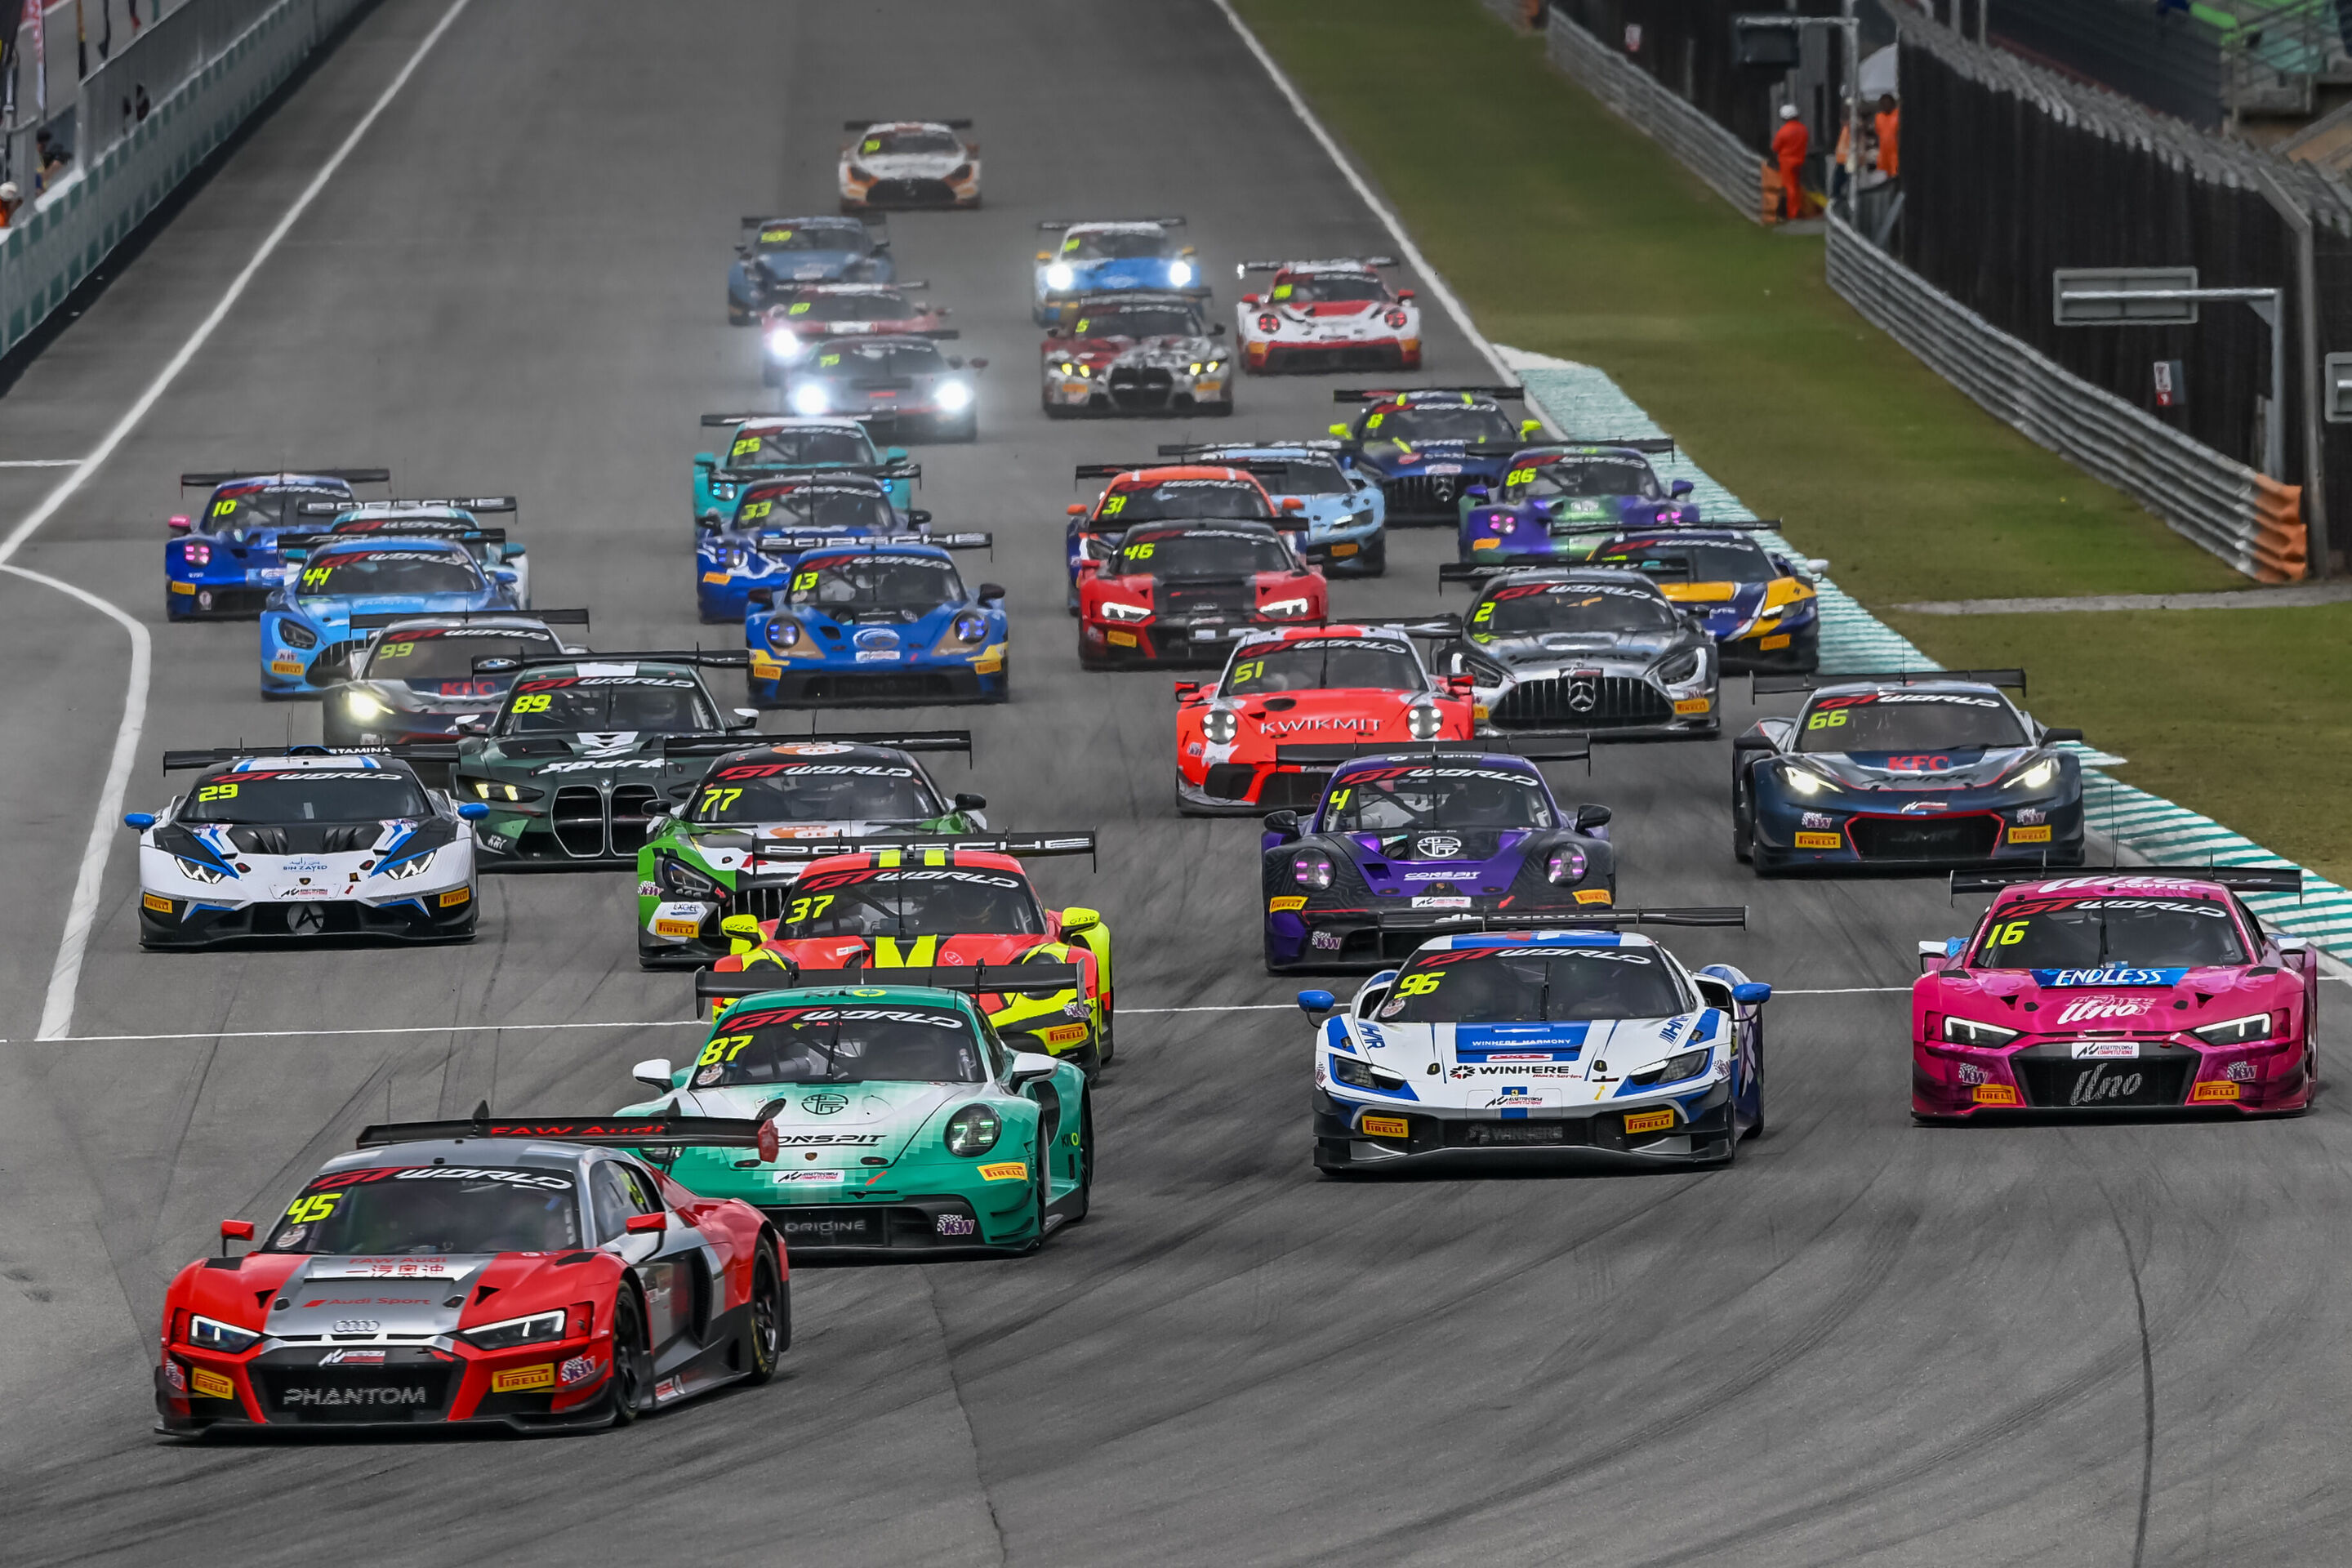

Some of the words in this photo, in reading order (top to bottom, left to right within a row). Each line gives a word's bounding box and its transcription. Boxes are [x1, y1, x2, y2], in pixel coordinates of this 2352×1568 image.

[212, 500, 237, 518] 10
[761, 532, 987, 548] PORSCHE
[302, 567, 333, 586] 44
[792, 572, 818, 591] 13
[1473, 601, 1496, 622] 2
[379, 643, 415, 660] 99
[1234, 661, 1264, 684] 51
[439, 681, 495, 697] KFC
[577, 677, 695, 688] WORLD
[511, 694, 552, 714] 89
[1878, 694, 2001, 707] WORLD
[1260, 719, 1384, 734] KWIKMIT
[1807, 709, 1849, 730] 66
[716, 763, 808, 781] GT
[782, 765, 913, 777] WORLD
[1887, 755, 1949, 771] KFC
[211, 771, 297, 783] GT
[274, 773, 403, 781] WORLD
[1337, 766, 1431, 786] GT
[1407, 768, 1539, 786] WORLD
[198, 783, 238, 803] 29
[700, 788, 743, 813] 77
[1329, 789, 1352, 811] 4
[764, 837, 1091, 854] PORSCHE
[1798, 835, 1837, 846] PIRELLI
[801, 868, 902, 892] GT
[875, 871, 1020, 889] WORLD
[2114, 883, 2191, 891] COFFEE
[786, 895, 835, 924] 37
[1997, 898, 2103, 919] GT
[2073, 900, 2227, 918] WORLD
[658, 922, 695, 934] PIRELLI
[1985, 921, 2029, 949] 16
[1416, 947, 1524, 968] GT
[1494, 948, 1652, 964] WORLD
[1393, 972, 1446, 999] 96
[2055, 969, 2167, 987] ENDLESS
[719, 1007, 832, 1032] GT
[800, 1009, 964, 1030] WORLD
[1049, 1026, 1084, 1042] PIRELLI
[699, 1034, 754, 1067] 87
[1479, 1065, 1570, 1075] WINHERE
[1976, 1087, 2016, 1102] PIRELLI
[2197, 1083, 2236, 1098] PIRELLI
[491, 1126, 573, 1135] FAW
[1365, 1120, 1404, 1134] PIRELLI
[1628, 1113, 1670, 1130] PIRELLI
[777, 1134, 888, 1144] ONSPIT
[309, 1166, 430, 1191] GT
[393, 1168, 572, 1191] WORLD
[983, 1165, 1025, 1178] PIRELLI
[286, 1192, 343, 1225] 45
[943, 1219, 975, 1236] KW
[345, 1263, 445, 1278] 一汽奥迪
[327, 1297, 374, 1306] Audi
[374, 1297, 431, 1306] Sport
[194, 1373, 229, 1395] PIRELLI
[497, 1368, 549, 1388] PIRELLI
[283, 1387, 426, 1405] PHANTOM
